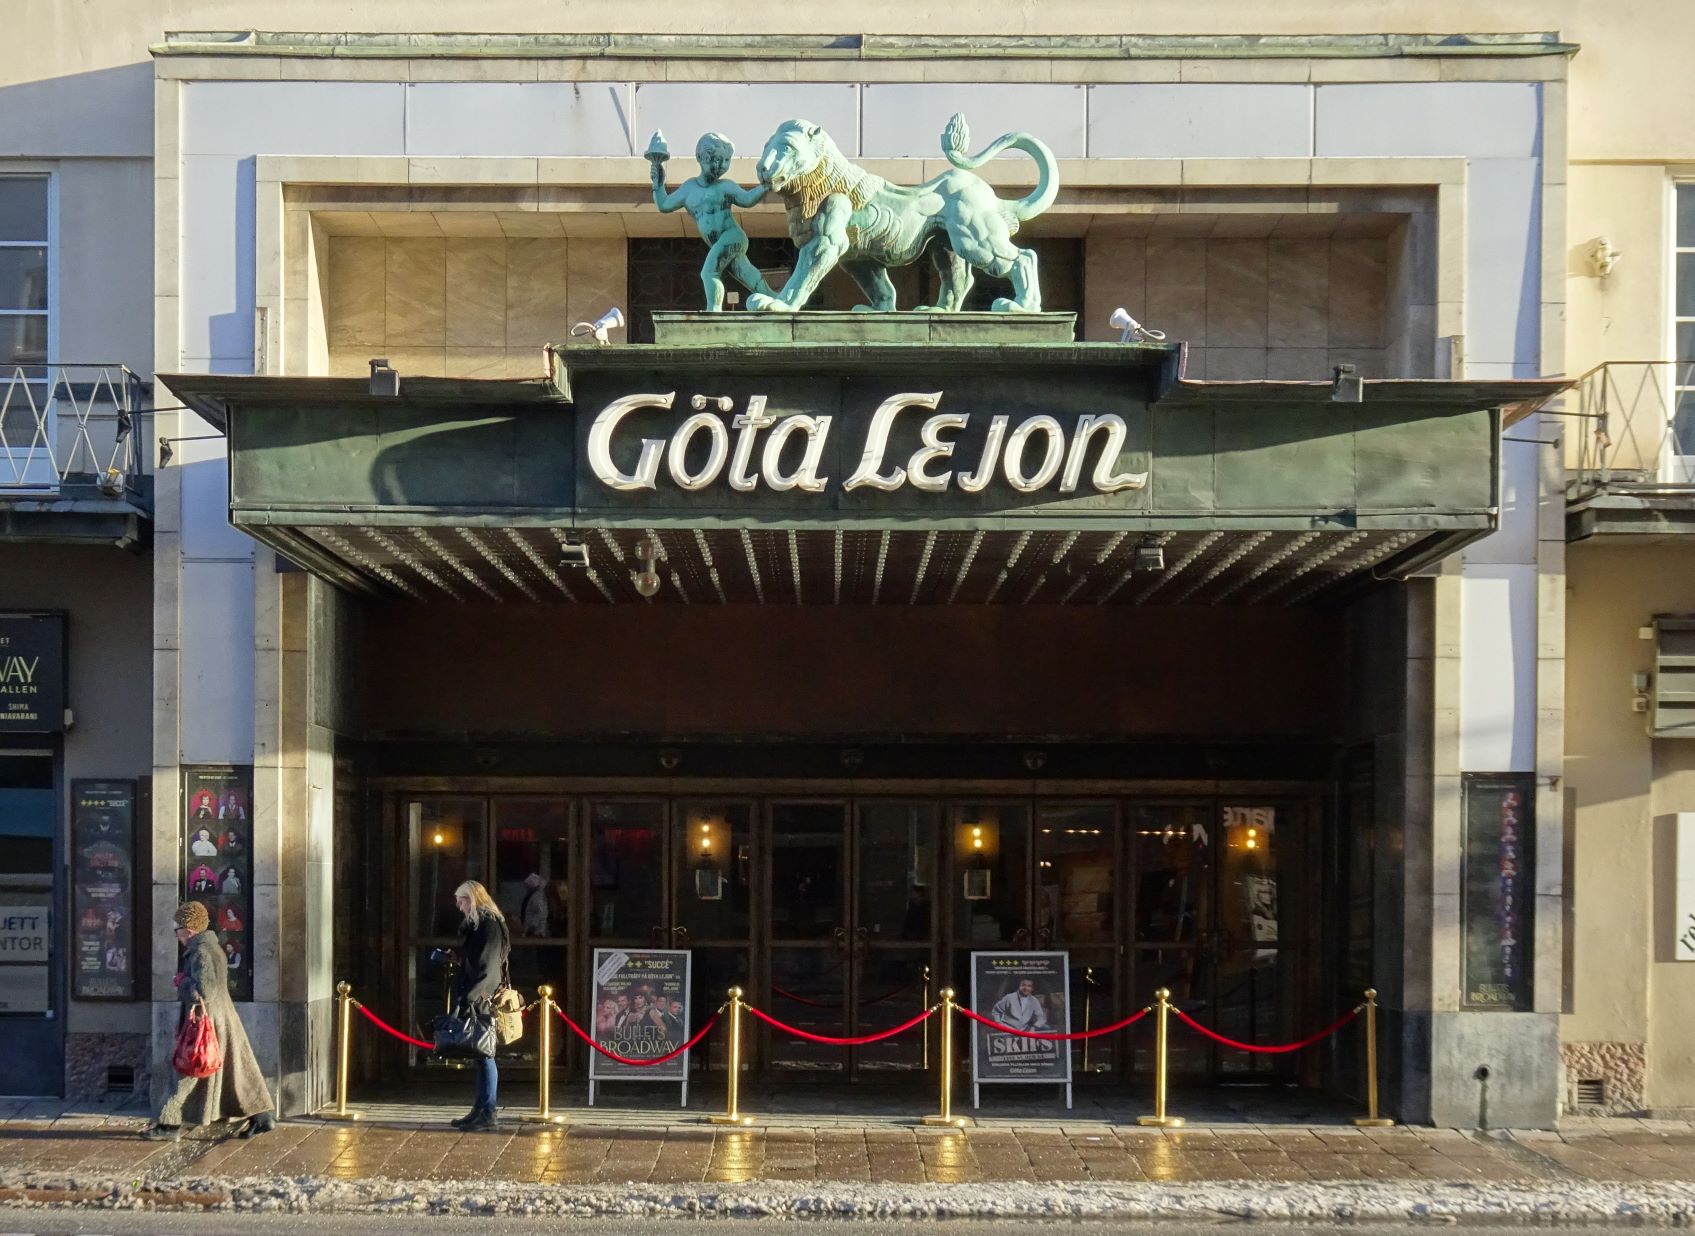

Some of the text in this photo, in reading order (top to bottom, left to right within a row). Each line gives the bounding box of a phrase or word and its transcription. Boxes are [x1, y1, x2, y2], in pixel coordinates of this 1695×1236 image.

[586, 391, 833, 493] Göta
[0, 685, 38, 694] ALLEN
[614, 1025, 666, 1040] BULLETS
[600, 1039, 680, 1056] BROADWAY
